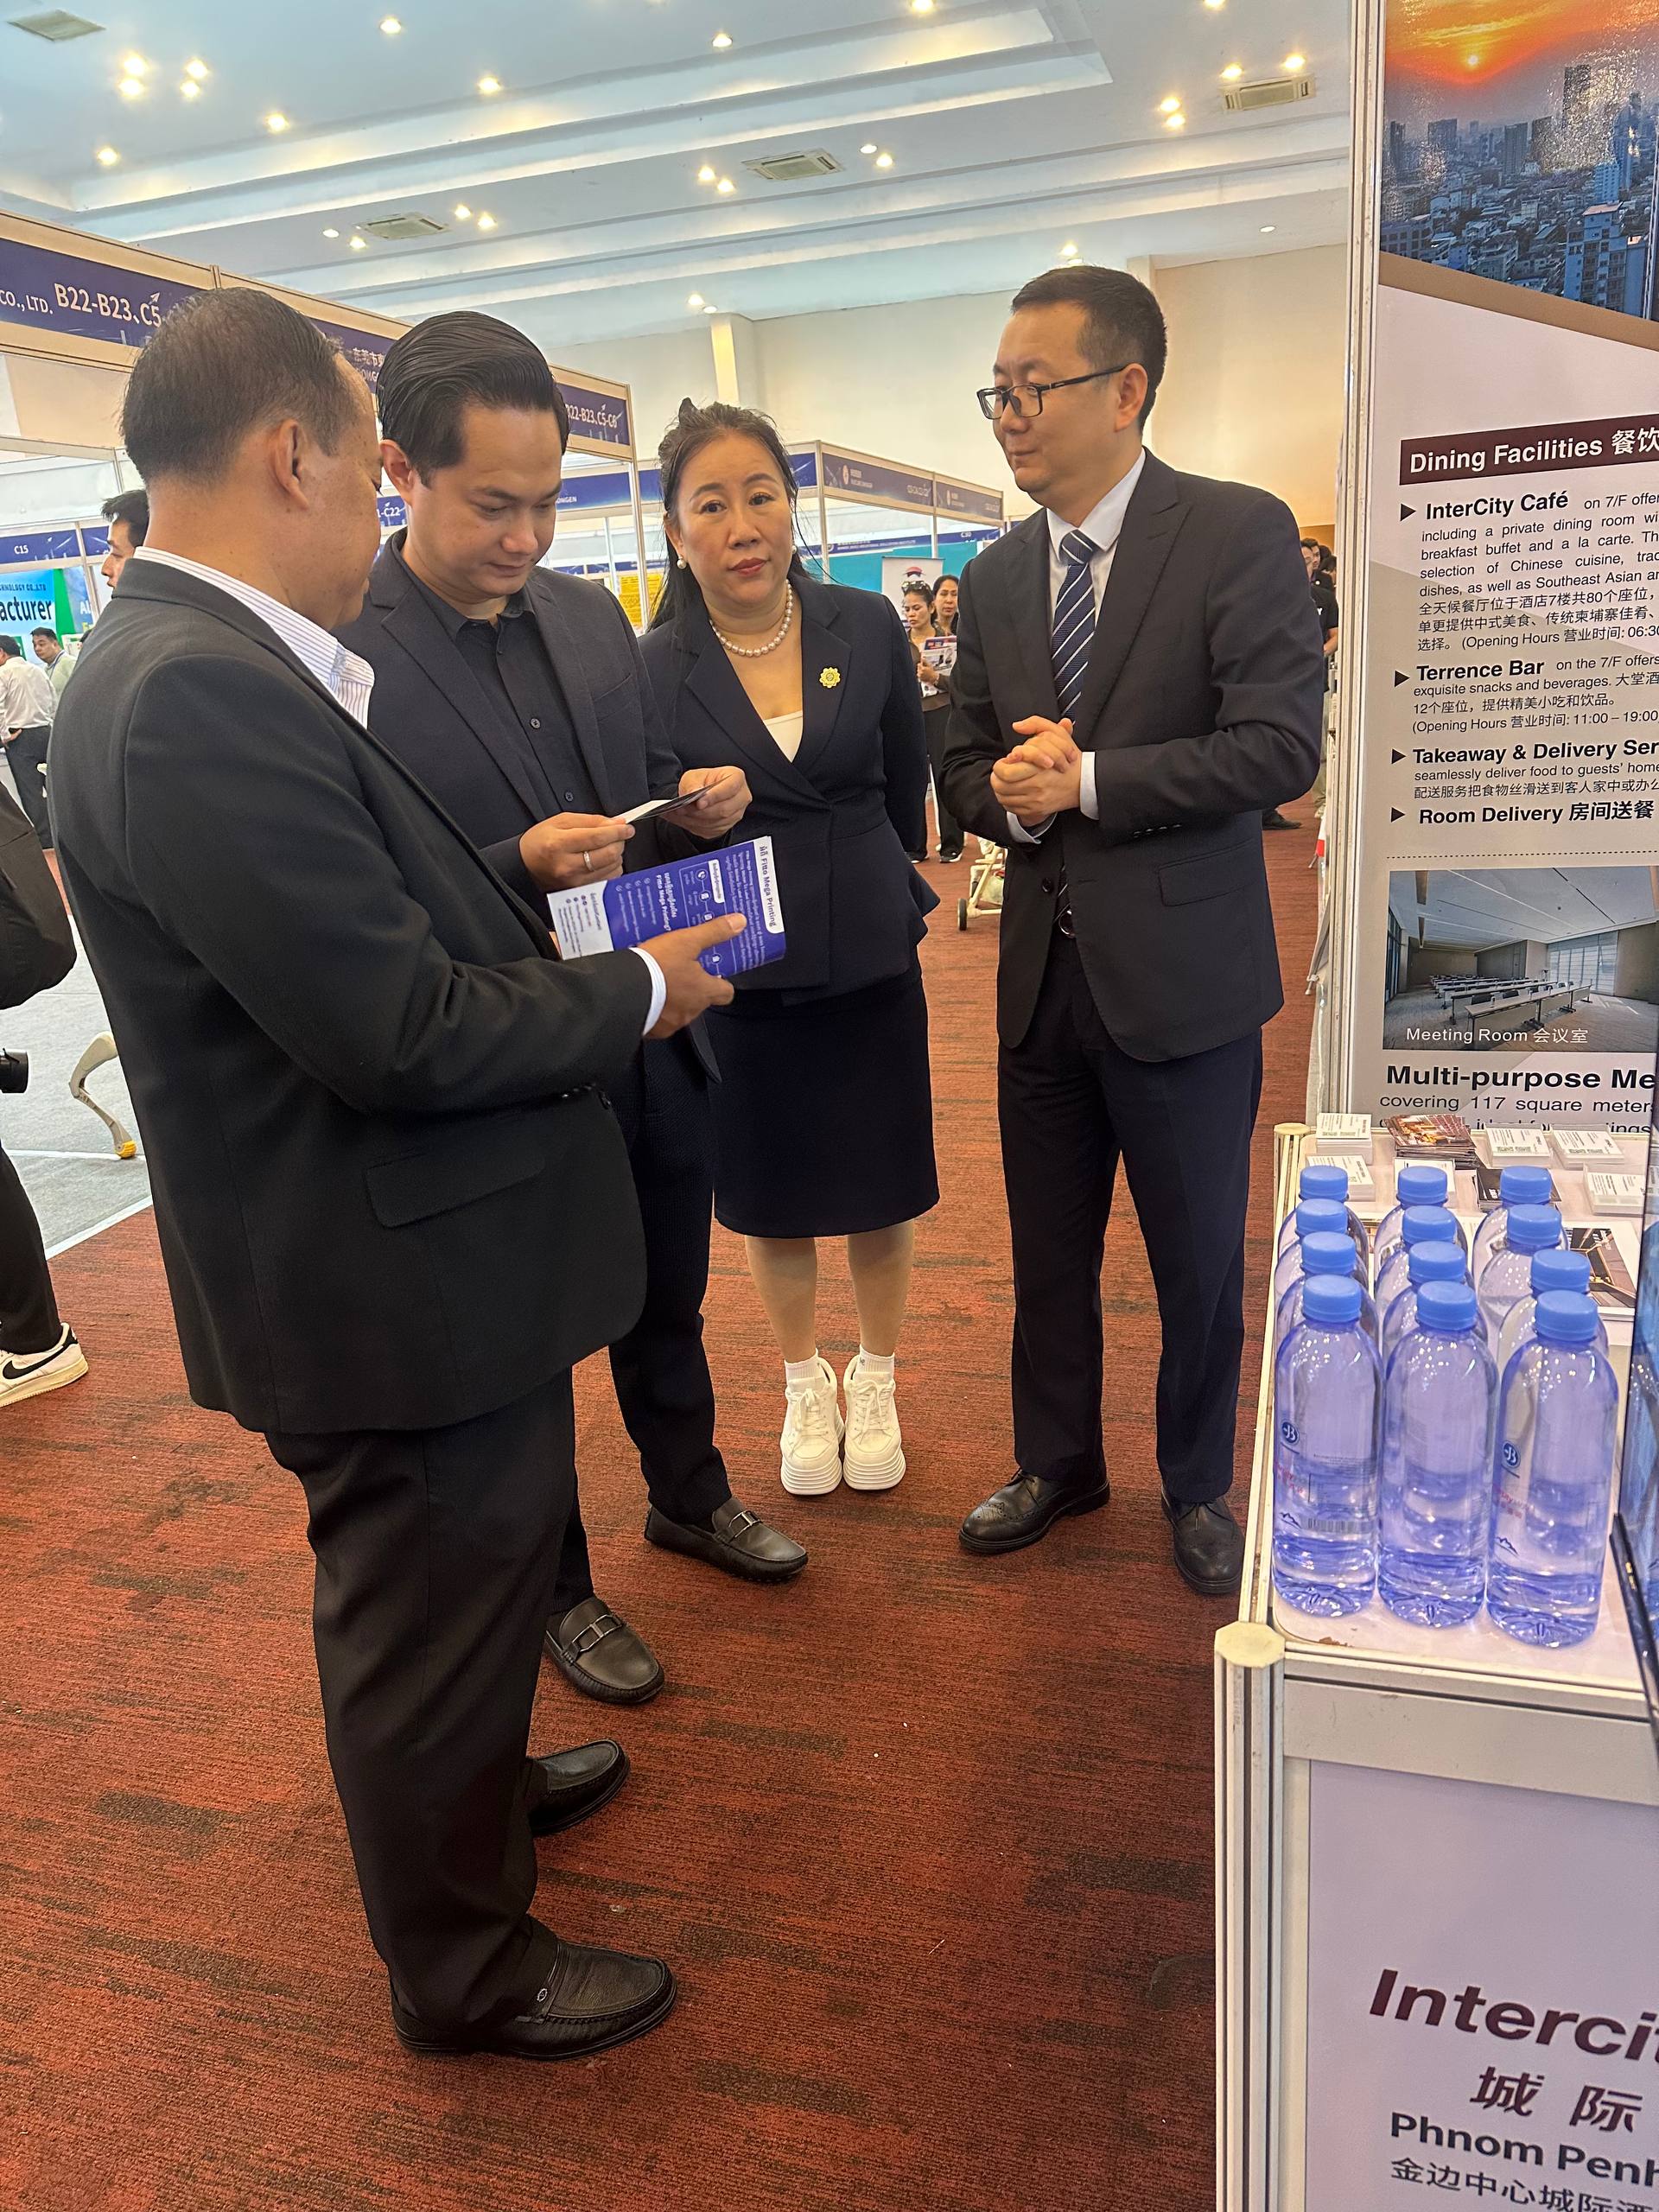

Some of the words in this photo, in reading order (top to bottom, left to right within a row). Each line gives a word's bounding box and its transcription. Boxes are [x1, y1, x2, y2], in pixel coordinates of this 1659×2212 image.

[1410, 449, 1486, 474] Dining
[1494, 436, 1603, 465] Facilities
[1611, 427, 1659, 455] 餐饮
[1426, 498, 1514, 520] InterCity
[1520, 490, 1569, 512] Café
[1584, 499, 1600, 510] on
[1606, 494, 1627, 508] 7/F
[1421, 527, 1477, 542] including
[1485, 527, 1494, 537] a
[1502, 523, 1544, 539] private
[1553, 518, 1592, 531] dining
[1601, 516, 1635, 527] room
[1644, 512, 1658, 524] wi
[14, 544, 29, 555] C15
[1421, 546, 1478, 561] breakfast
[1485, 542, 1522, 556] buffet
[1529, 539, 1553, 552] and
[1561, 540, 1569, 550] a
[1578, 537, 1589, 548] la
[1598, 534, 1634, 546] carte.
[1641, 531, 1659, 543] Th
[1420, 564, 1475, 579] selection
[1486, 562, 1500, 575] of
[1510, 557, 1563, 572] Chinese
[1575, 554, 1624, 567] cuisine,
[1420, 582, 1463, 597] dishes,
[1467, 583, 1483, 594] as
[1487, 580, 1511, 592] well
[1516, 579, 1531, 590] as
[1535, 574, 1601, 589] Southeast
[1605, 571, 1642, 583] Asian
[1417, 637, 1451, 652] 选择。
[1462, 634, 1519, 651] (Opening
[1522, 632, 1560, 645] Hours
[1564, 626, 1625, 642] 营业时间:
[1416, 662, 1503, 681] Terrence
[1509, 660, 1545, 677] Bar
[1556, 661, 1572, 671] on
[1576, 658, 1597, 669] the
[1600, 656, 1622, 668] 7/F
[1625, 654, 1659, 666] offers
[1414, 683, 1466, 698] exquisite
[1469, 681, 1512, 695] snacks
[1516, 679, 1540, 691] and
[1543, 677, 1611, 690] beverages.
[1616, 671, 1659, 687] 大堂酒
[1412, 718, 1468, 734] (Opening
[1471, 717, 1508, 730] Hours
[1510, 714, 1570, 728] 营业时间:
[1573, 713, 1608, 725] 11:00
[1624, 710, 1659, 723] 19:00
[1413, 746, 1507, 765] Takeaway
[1513, 745, 1527, 760] &
[1533, 742, 1618, 761] Delivery
[1623, 739, 1659, 755] Ser
[1414, 768, 1481, 782] seamlessly
[1485, 767, 1525, 780] deliver
[1529, 765, 1557, 778] food
[1561, 765, 1573, 775] to
[1420, 807, 1476, 824] Room
[1482, 804, 1563, 824] Delivery
[1568, 800, 1655, 821] 房间送餐
[766, 897, 778, 928] Printing
[1406, 1028, 1473, 1044] Meeting
[1478, 1029, 1528, 1042] Room
[1533, 1028, 1588, 1044] 会议室
[1386, 1065, 1601, 1091] Multi-purpose
[1611, 1069, 1656, 1089] Me
[1379, 1096, 1459, 1111] covering
[1471, 1096, 1506, 1109] 117
[1516, 1098, 1582, 1114] square
[1592, 1100, 1653, 1113] meter
[1370, 1968, 1659, 2063] Interci
[1391, 2112, 1543, 2166] Phnom
